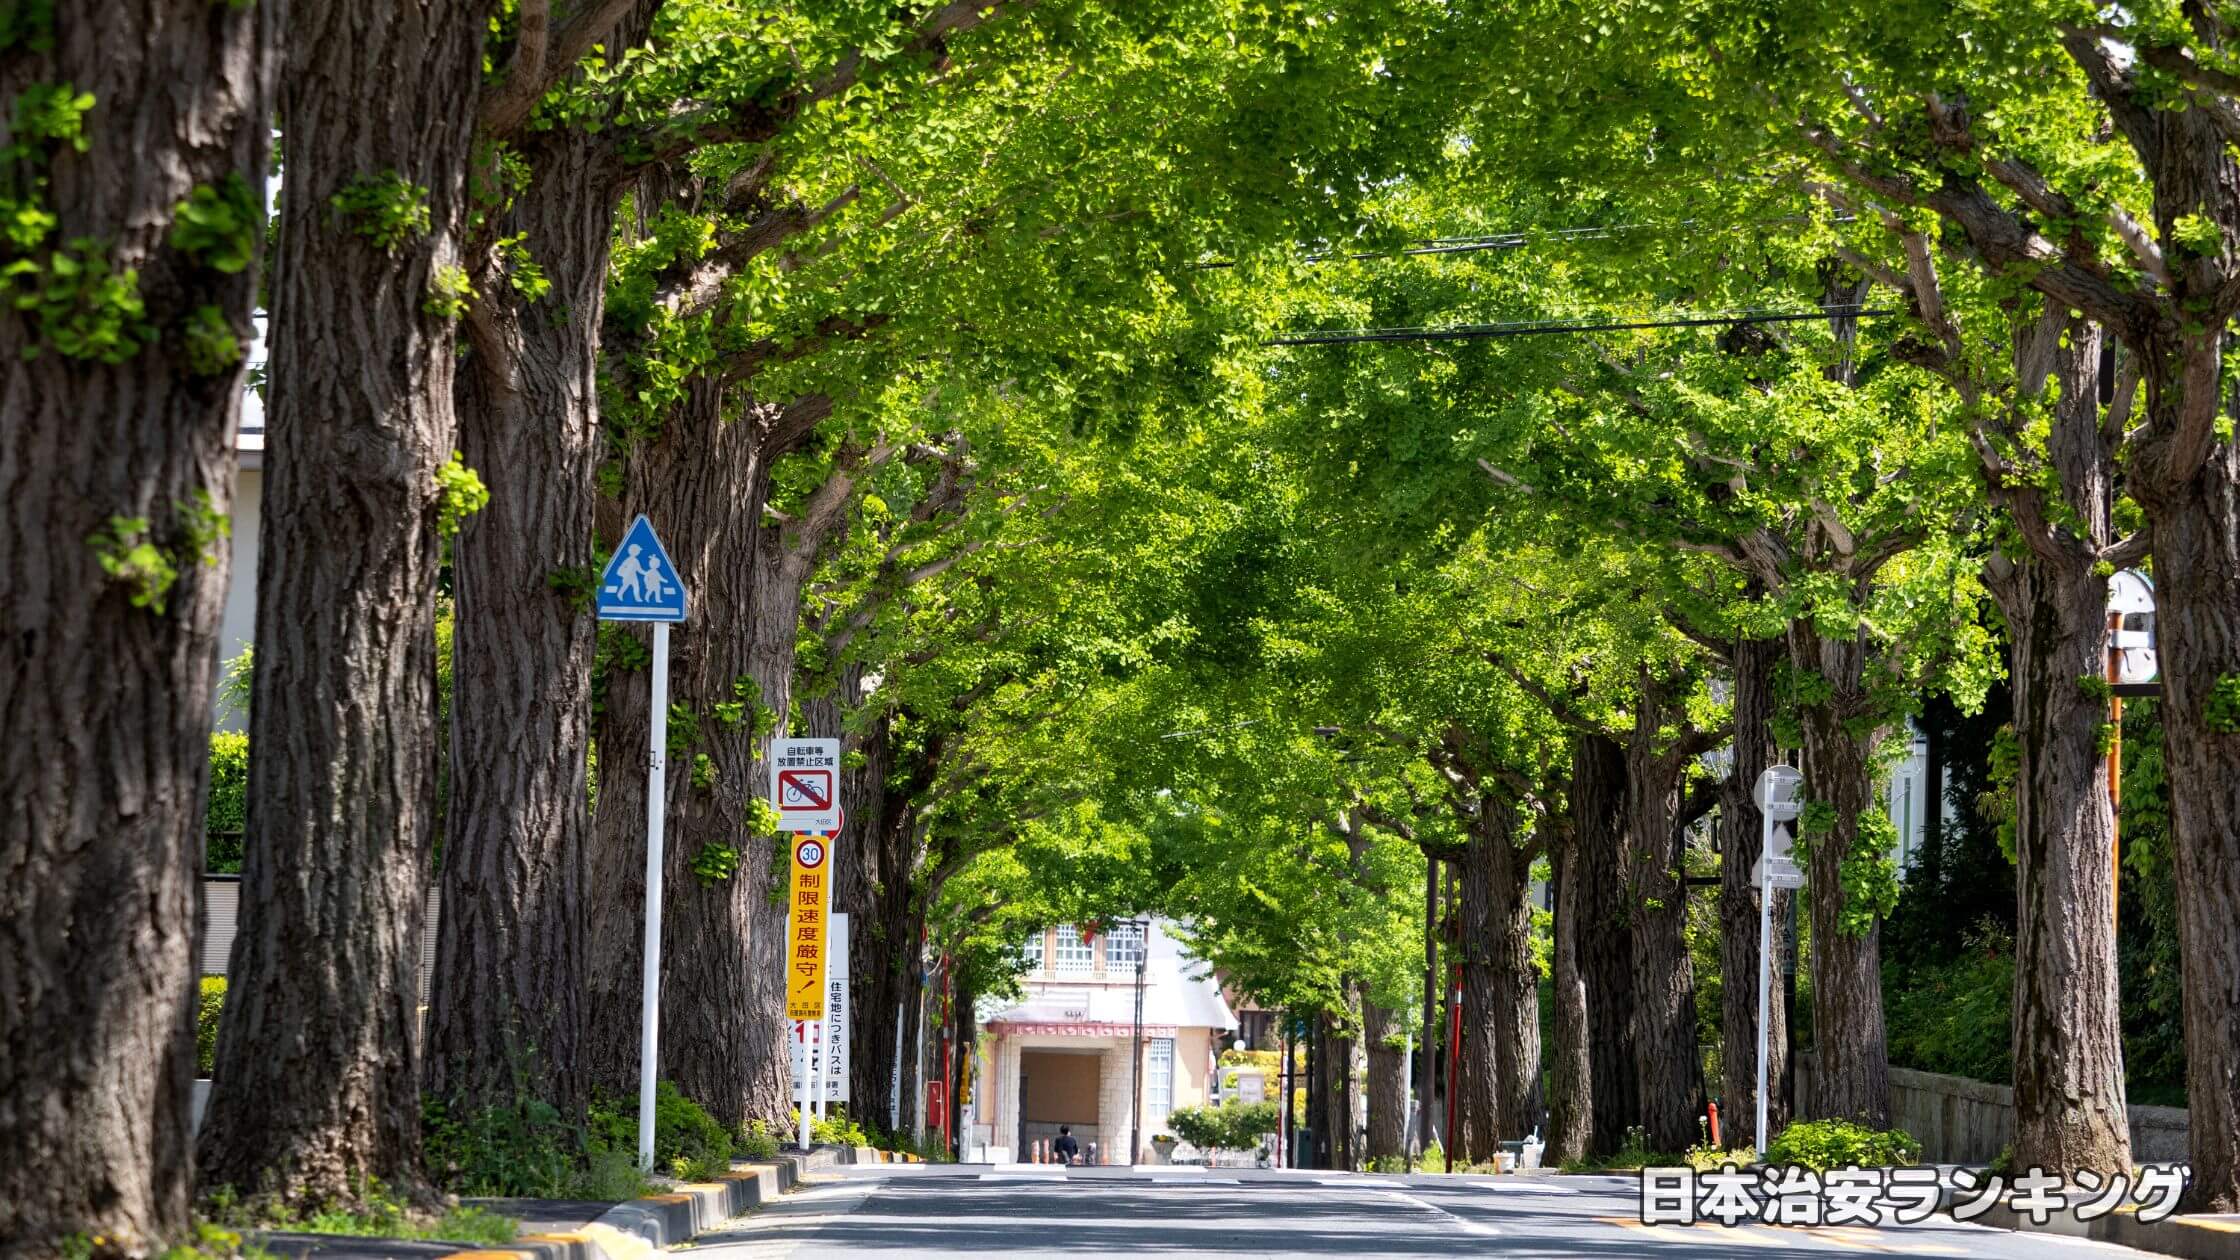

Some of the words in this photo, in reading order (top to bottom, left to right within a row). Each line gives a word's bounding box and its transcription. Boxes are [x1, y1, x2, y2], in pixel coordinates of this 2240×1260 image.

[787, 746, 824, 756] 自転車等
[777, 757, 834, 767] 放置禁止区域
[802, 847, 819, 861] 30
